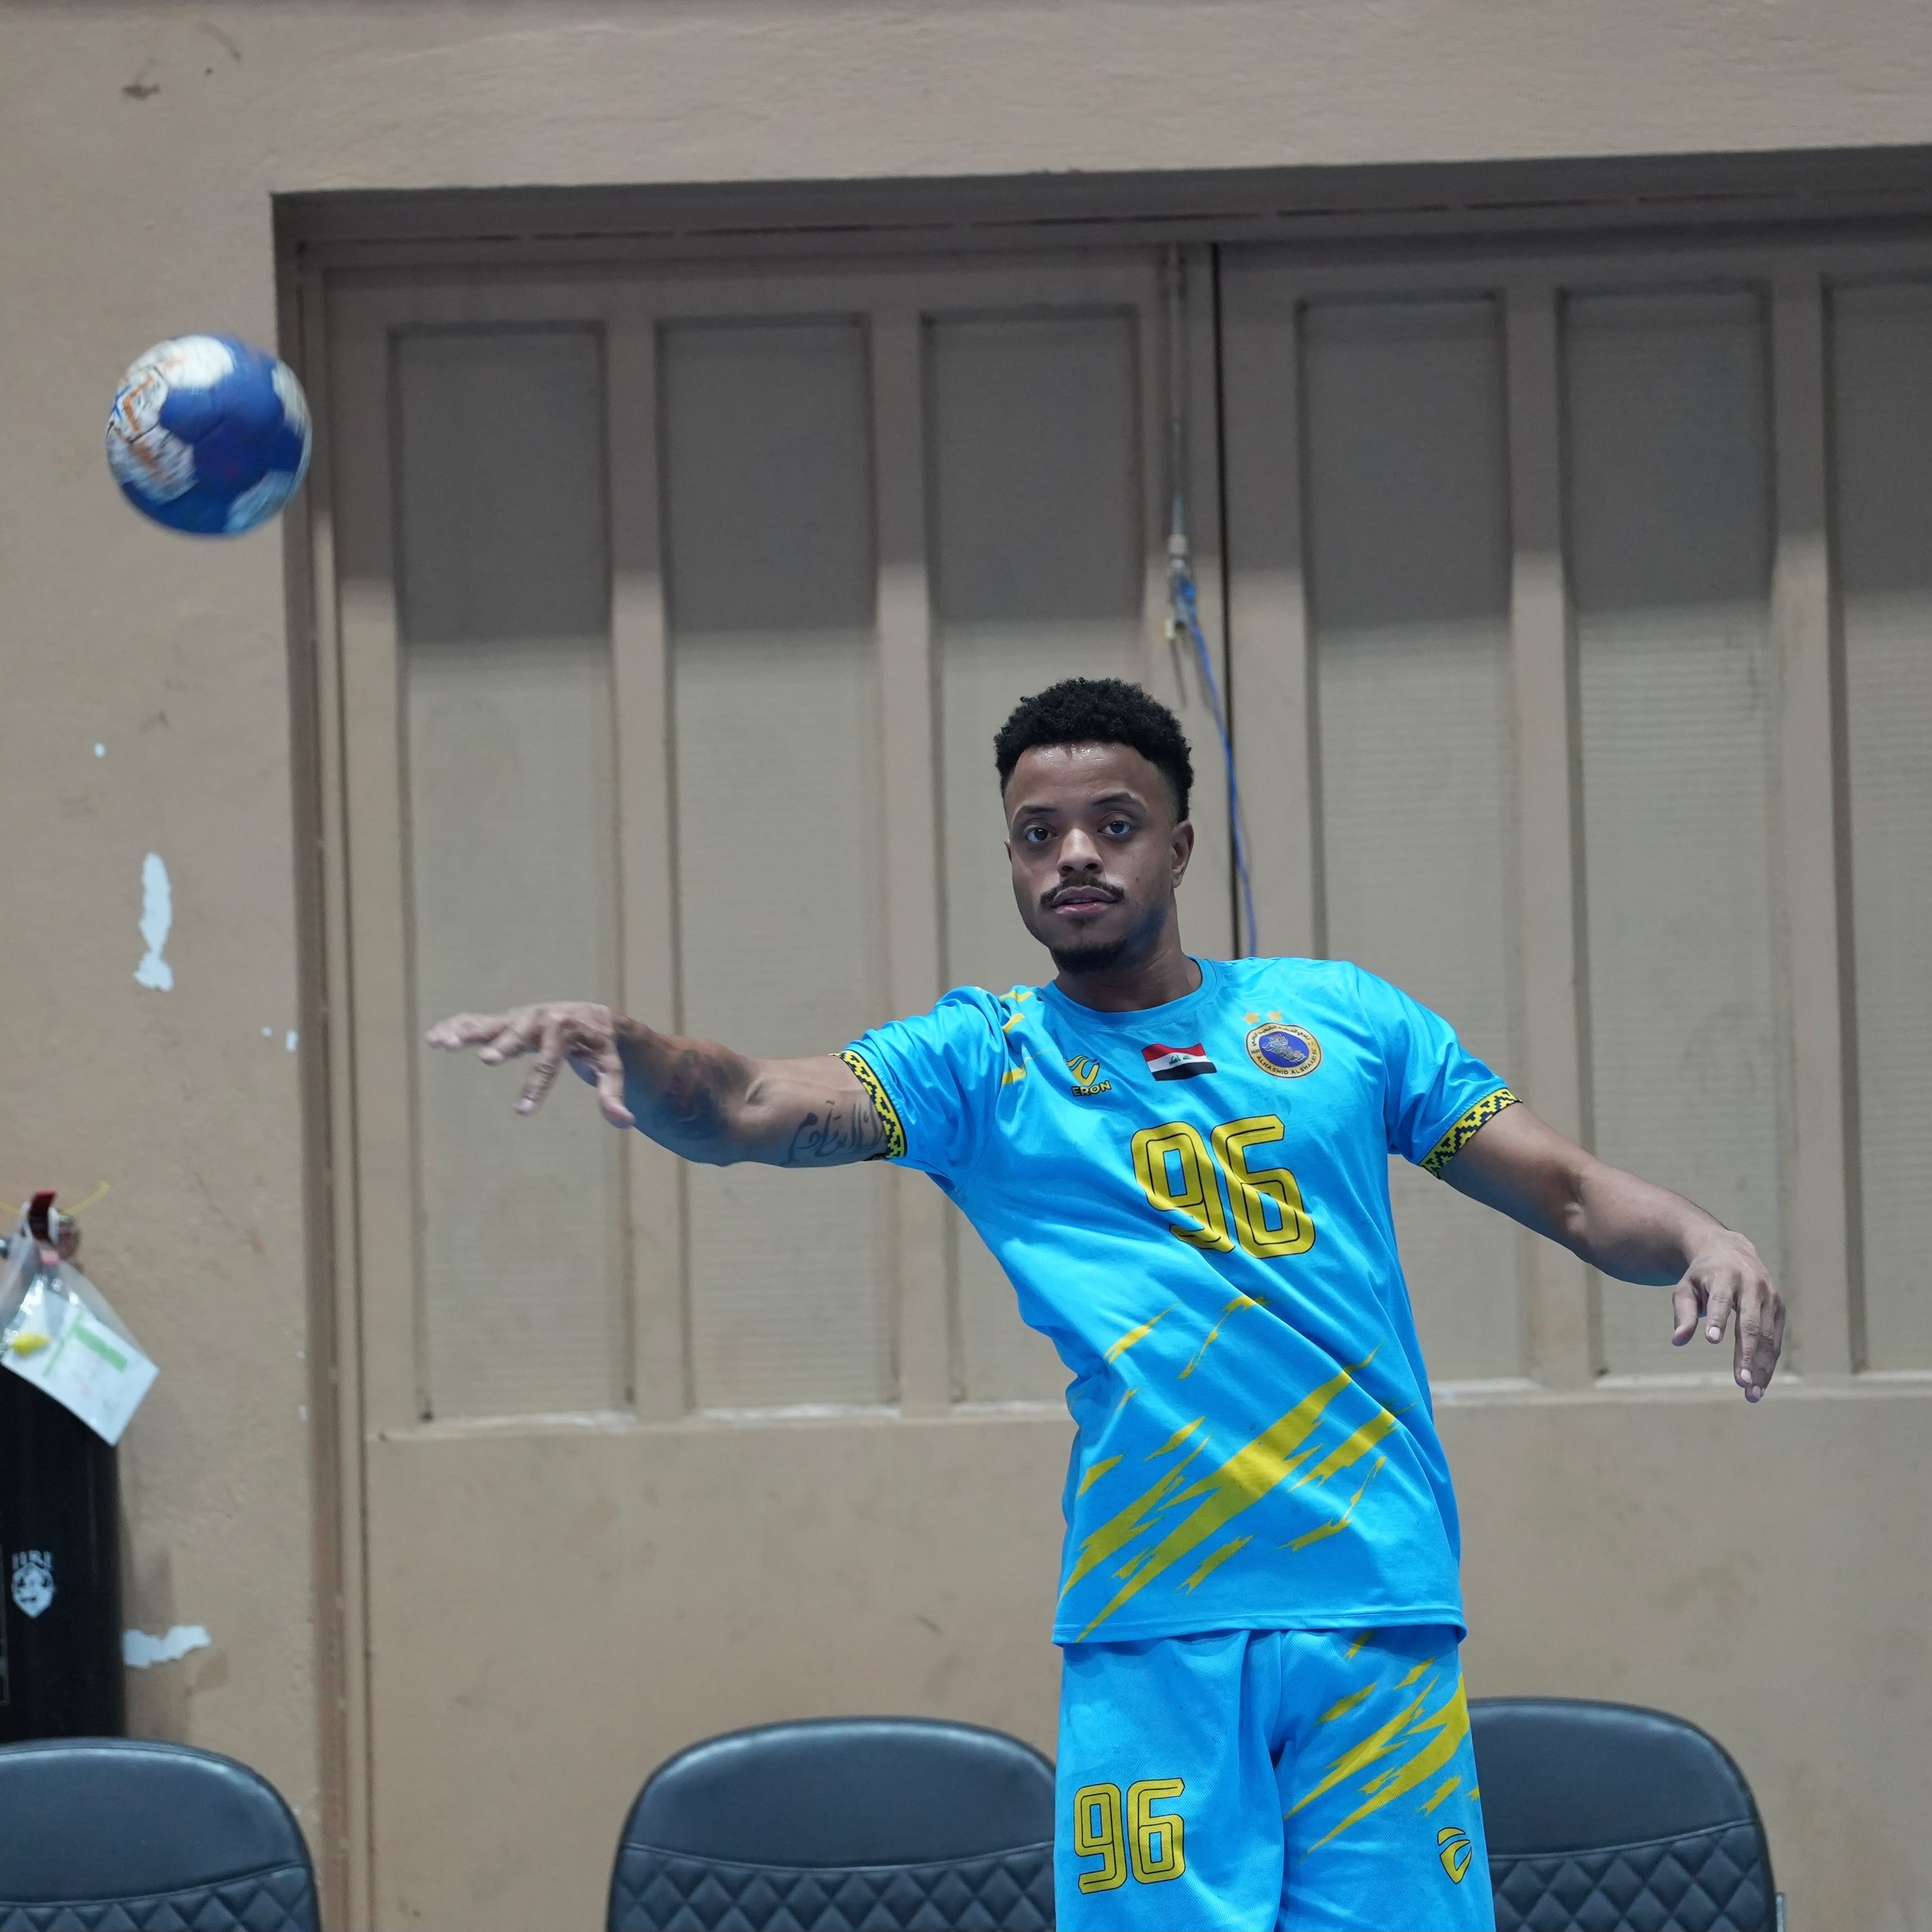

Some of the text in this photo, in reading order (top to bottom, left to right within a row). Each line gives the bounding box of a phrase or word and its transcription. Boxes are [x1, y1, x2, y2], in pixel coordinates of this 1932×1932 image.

[1071, 1080, 1112, 1097] ERON
[1256, 1056, 1289, 1075] ALHASHID
[1291, 1056, 1317, 1075] ALSHAABI
[1130, 1115, 1316, 1259] 96
[1074, 1778, 1186, 1894] 96
